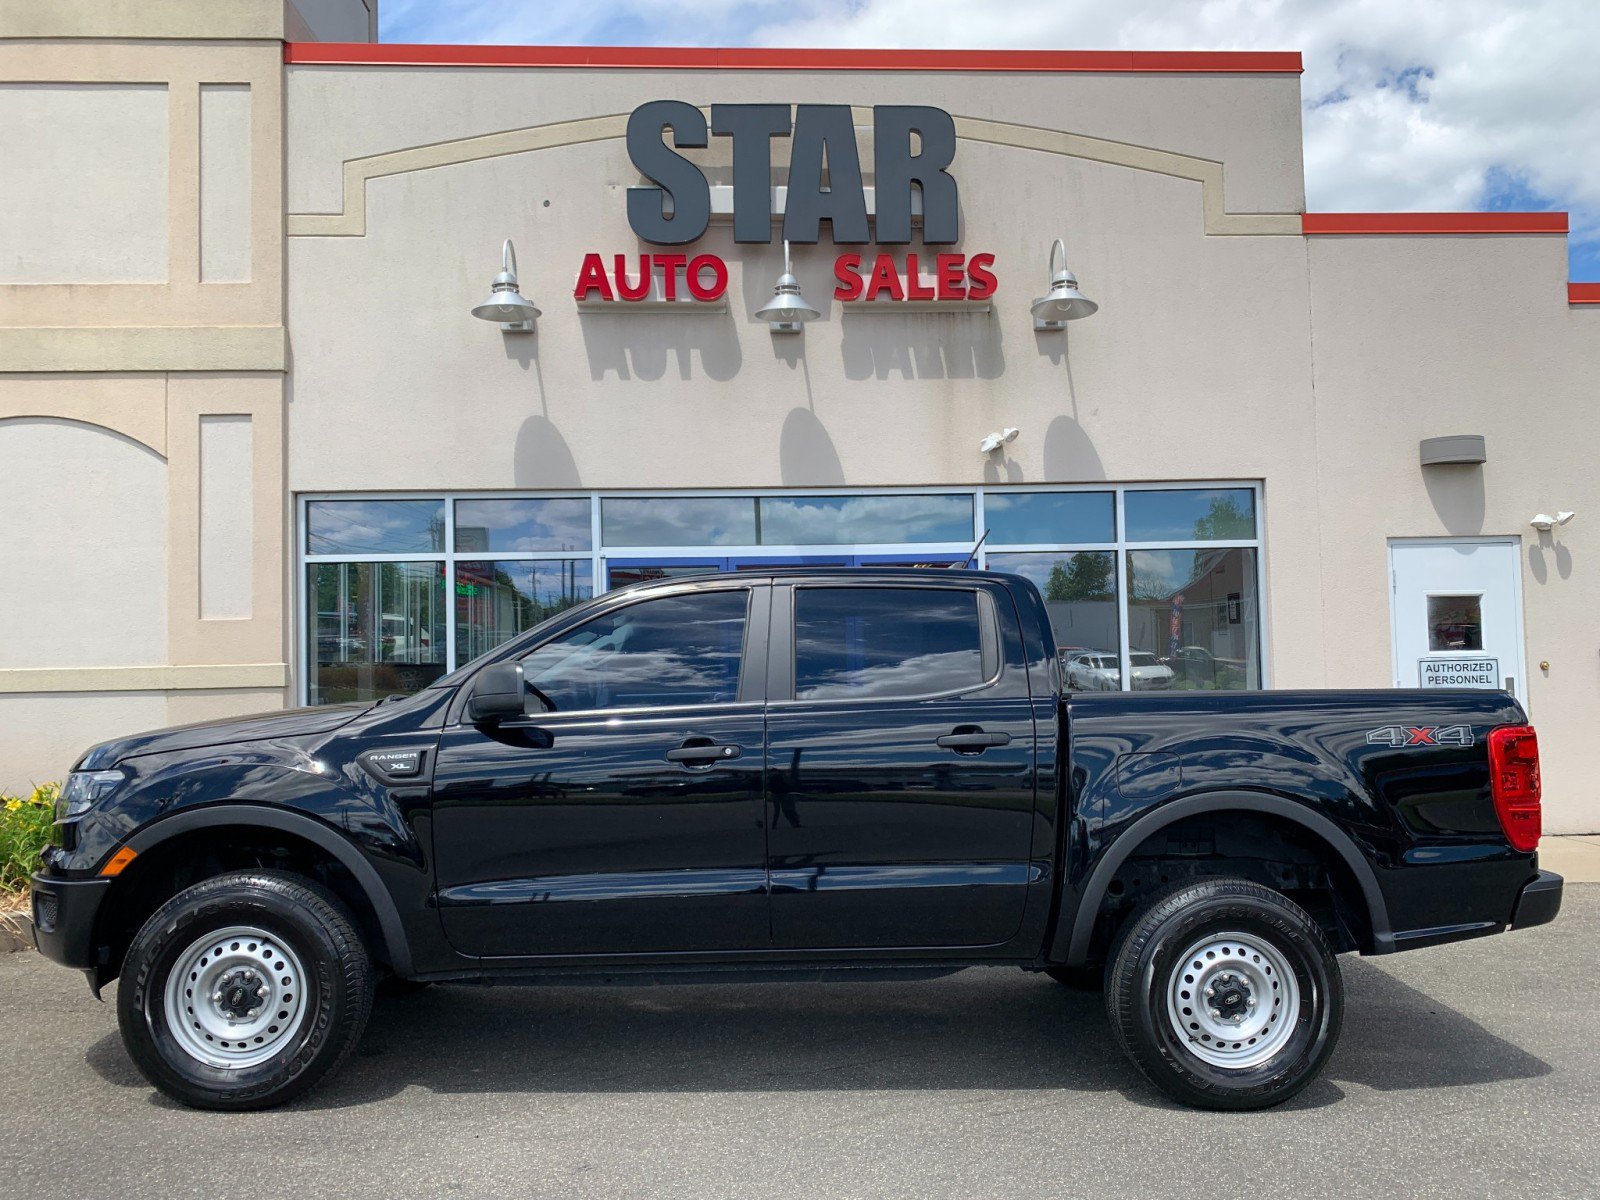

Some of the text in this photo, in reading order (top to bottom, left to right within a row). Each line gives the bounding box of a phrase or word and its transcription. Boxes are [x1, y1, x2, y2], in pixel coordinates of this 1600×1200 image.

[626, 100, 958, 246] STAR
[573, 253, 998, 301] AUTO SALES
[1425, 663, 1493, 673] AUTHORIZED
[1428, 675, 1492, 684] PERSONNEL
